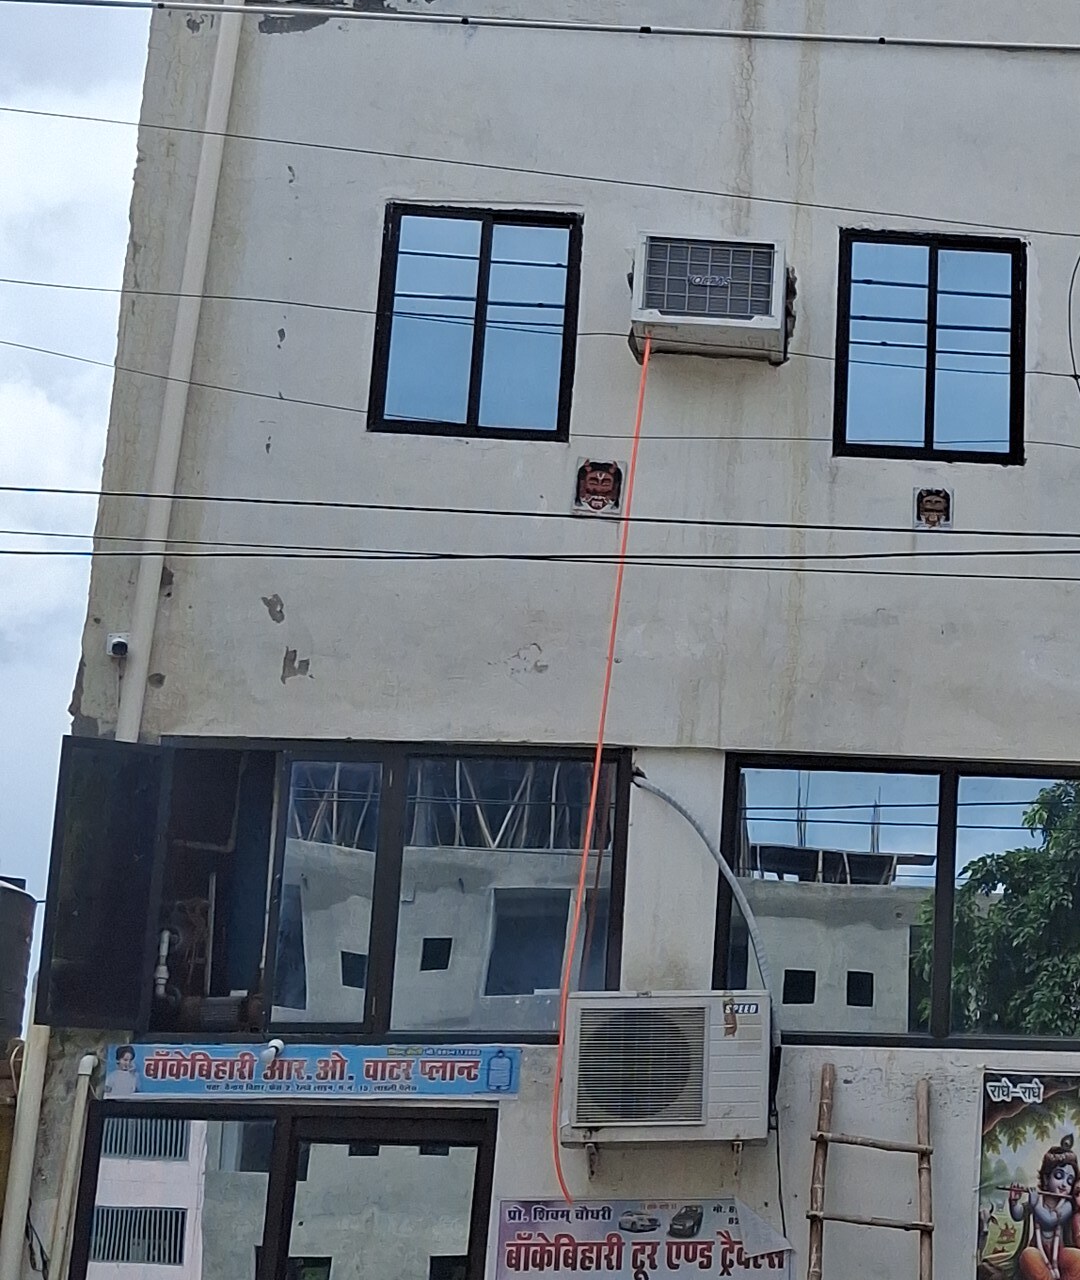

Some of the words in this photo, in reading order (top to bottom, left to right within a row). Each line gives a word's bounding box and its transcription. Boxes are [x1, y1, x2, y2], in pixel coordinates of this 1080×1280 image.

[364, 1058, 414, 1081] वाटर
[420, 1058, 481, 1081] प्लान्ट
[507, 1206, 528, 1222] प्रो.
[575, 1206, 612, 1221] चौधरी
[665, 1241, 715, 1270] एण्ड
